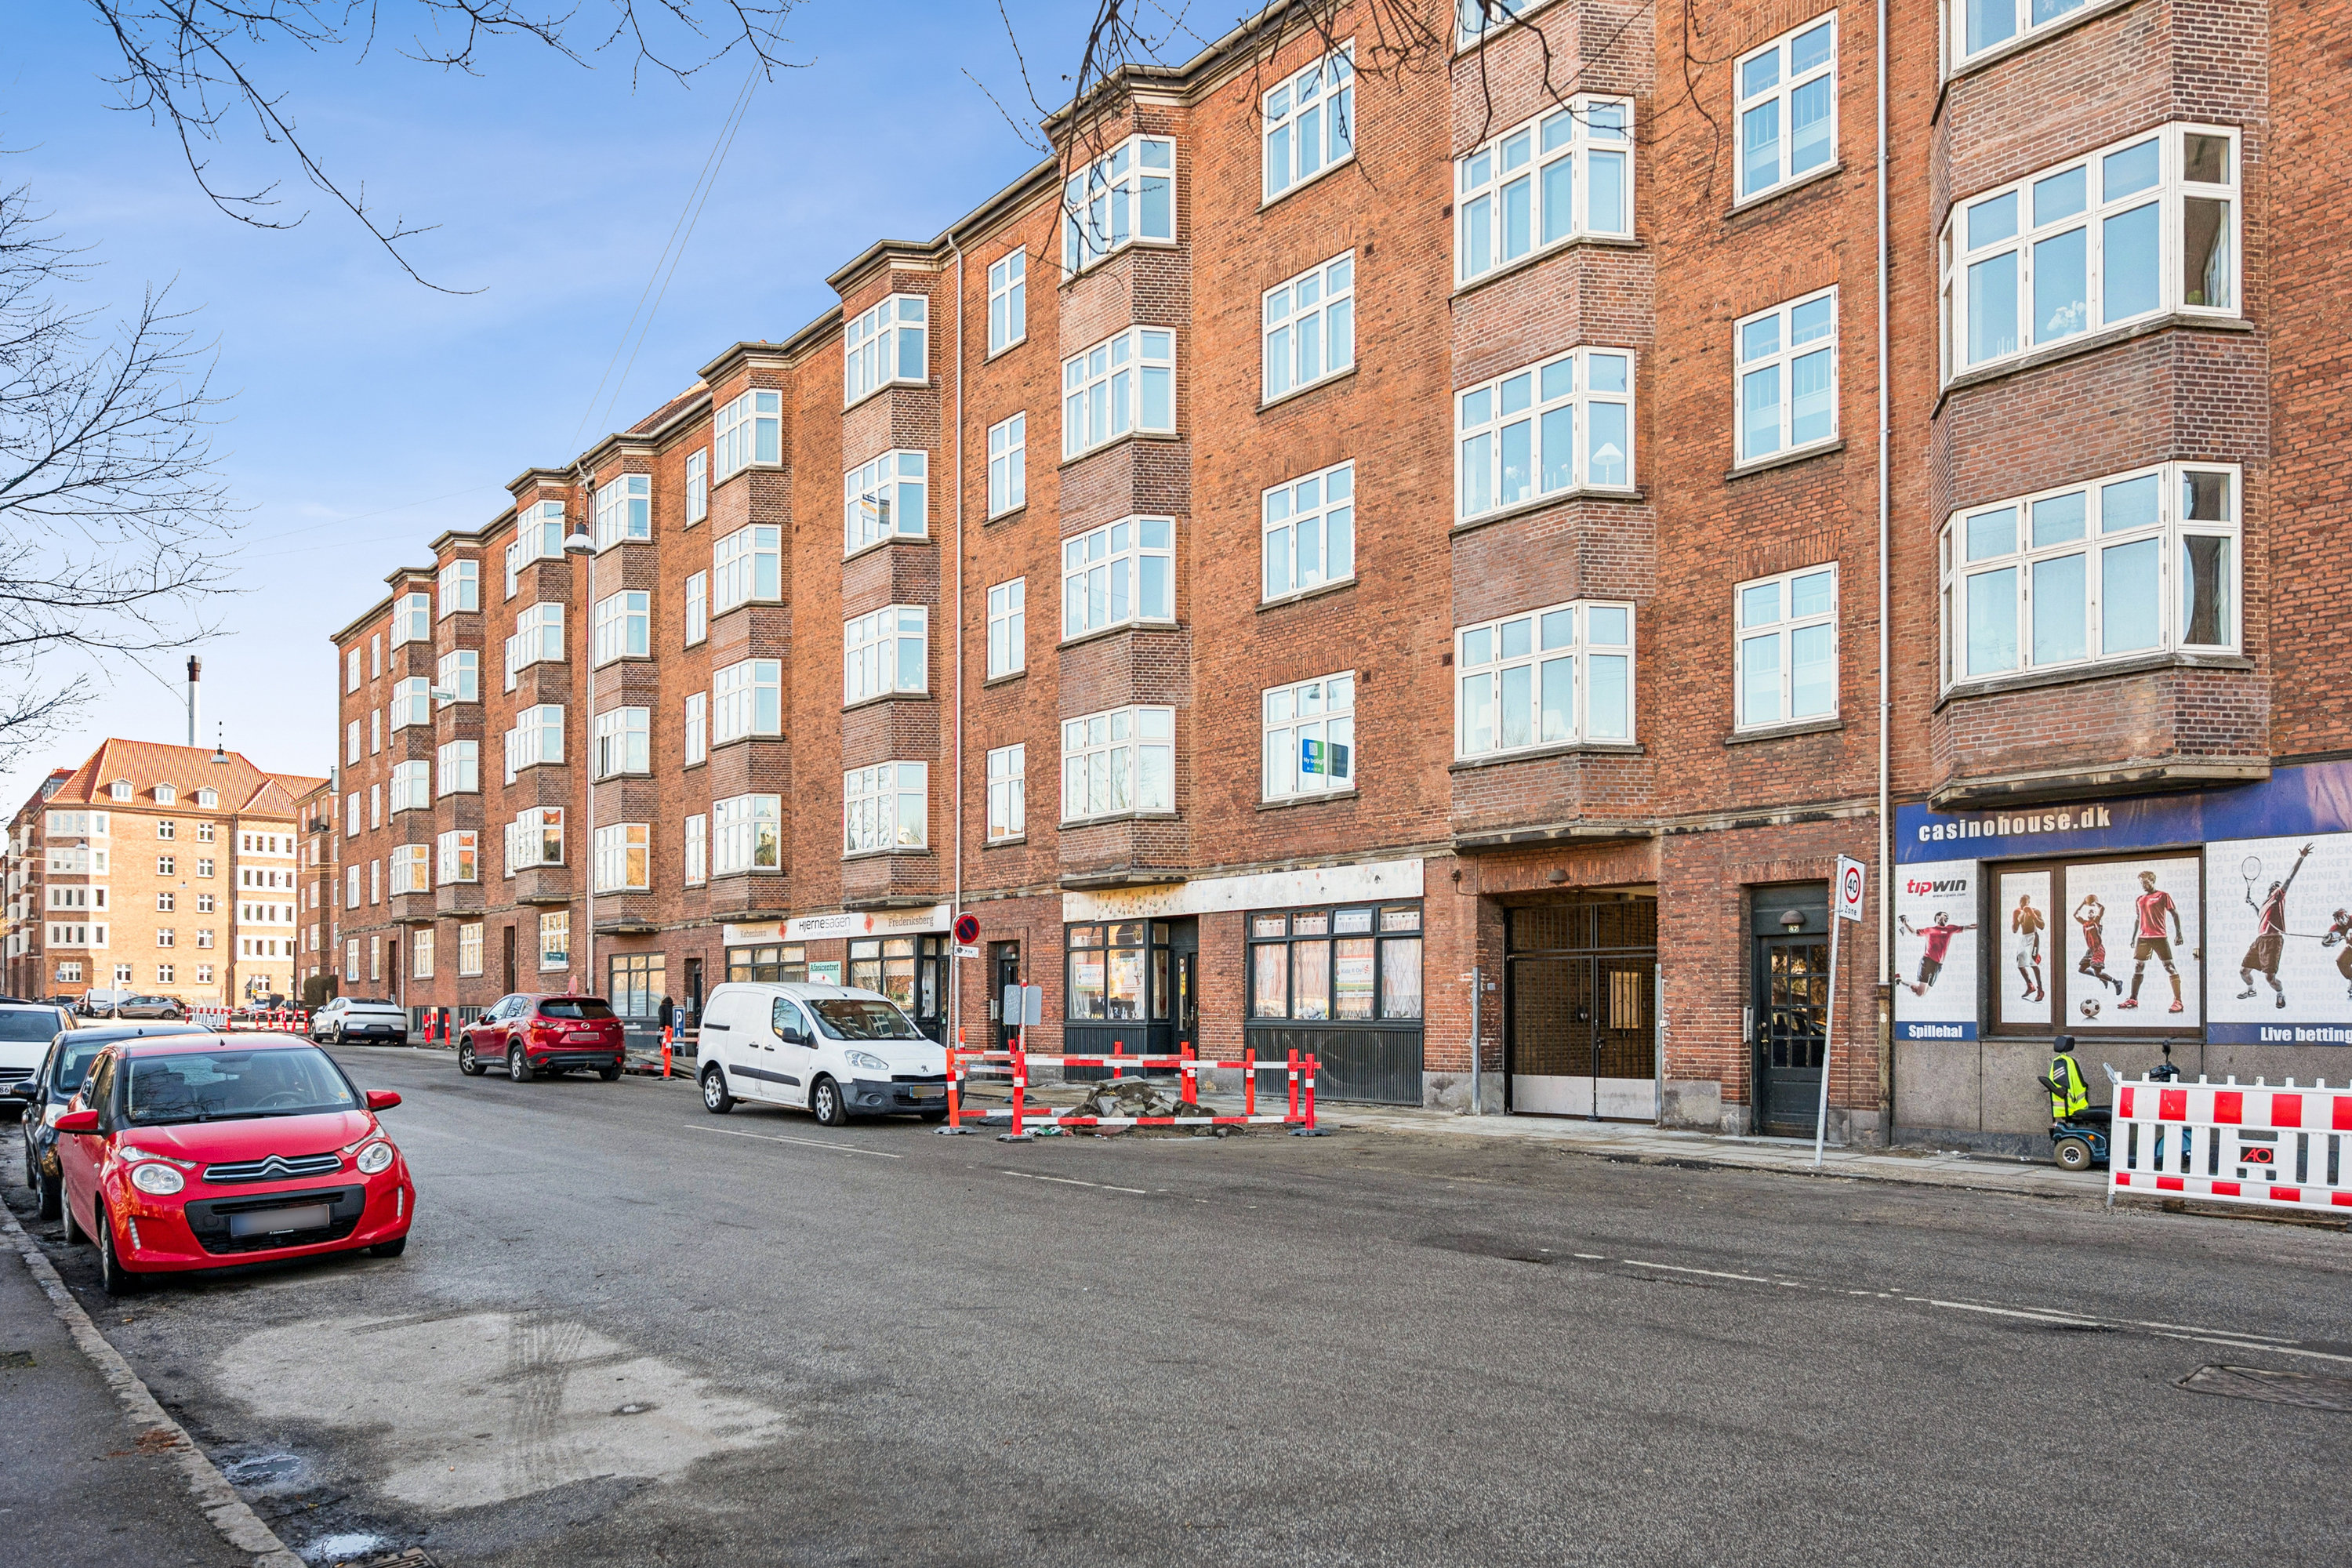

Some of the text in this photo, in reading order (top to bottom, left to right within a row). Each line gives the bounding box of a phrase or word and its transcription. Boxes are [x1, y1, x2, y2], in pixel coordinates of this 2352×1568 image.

[1919, 807, 2111, 842] casinohouse.dk
[1847, 878, 1857, 893] 40
[1907, 879, 1967, 897] tipwin
[1845, 905, 1857, 916] Zone
[889, 915, 934, 927] Frederiksberg
[676, 1011, 682, 1028] P
[1909, 1025, 1962, 1038] Spillehal
[2261, 1027, 2352, 1044] Live betting
[2243, 1148, 2271, 1163] AO
